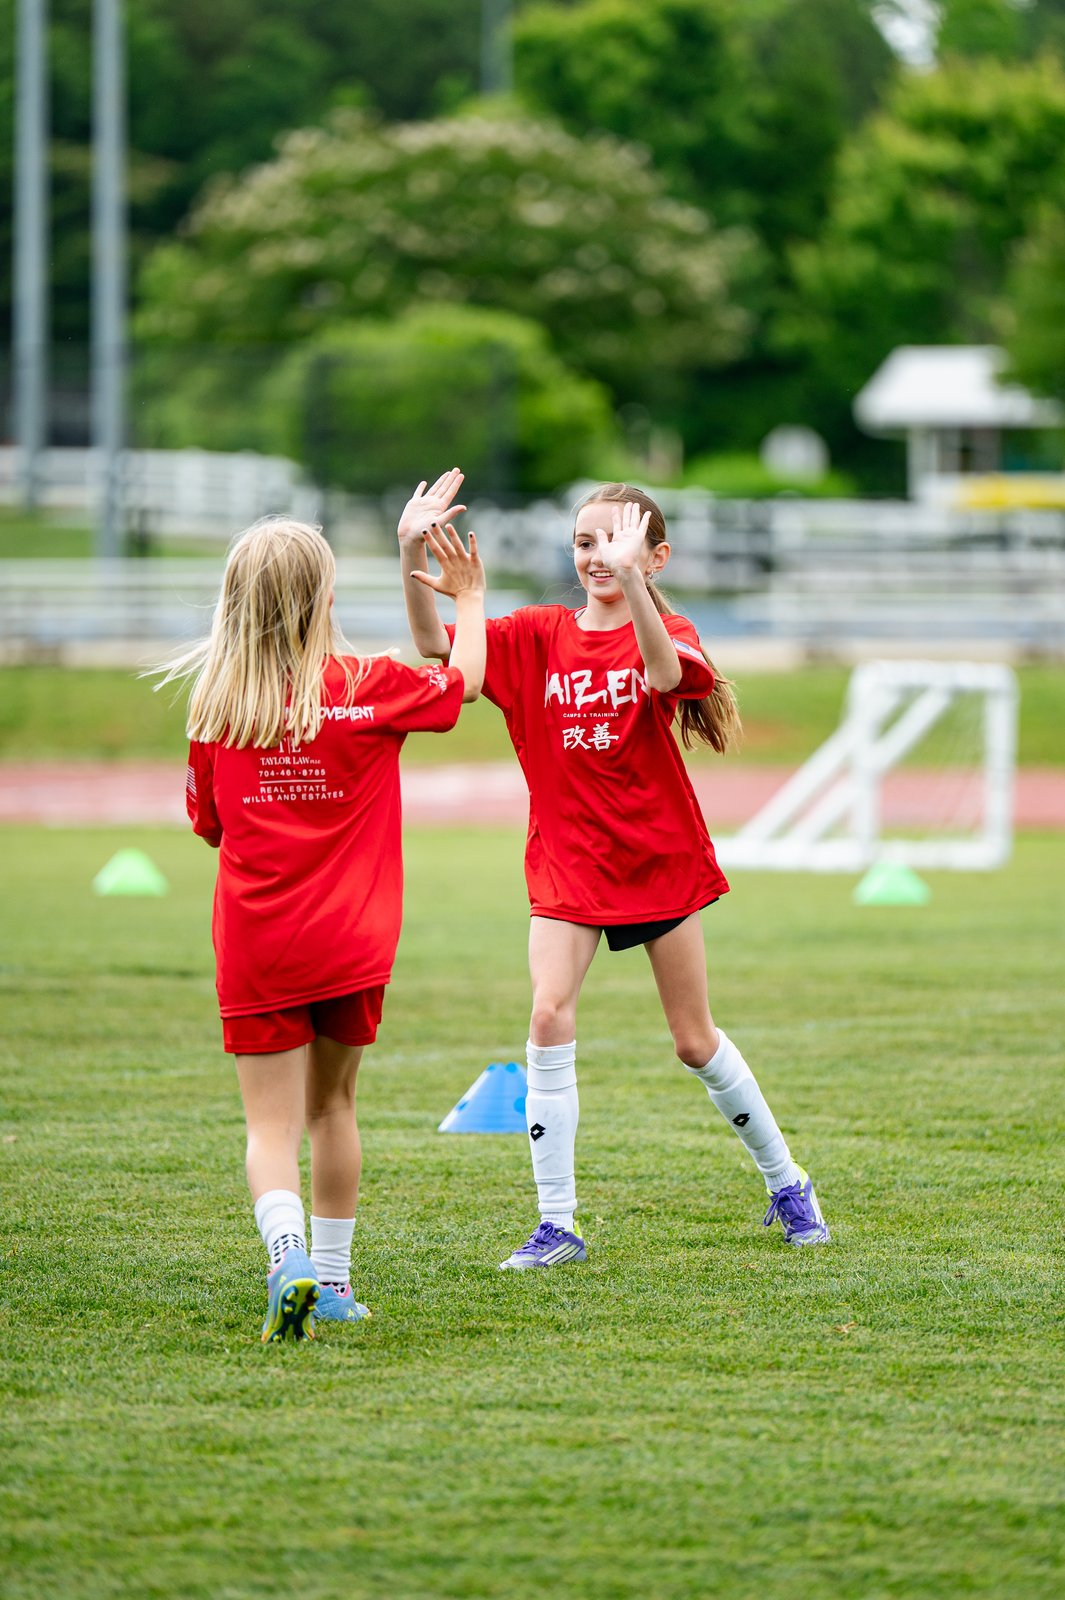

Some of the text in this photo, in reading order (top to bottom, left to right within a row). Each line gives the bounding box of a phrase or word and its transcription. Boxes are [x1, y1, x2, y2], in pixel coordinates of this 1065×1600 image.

[311, 705, 375, 722] OVEMENT
[562, 721, 620, 752] 改善
[260, 756, 291, 766] TAYLOR
[292, 756, 310, 765] LAW
[260, 784, 327, 794] REAL ESTATE
[242, 790, 344, 804] WILLS AND ESTATES
